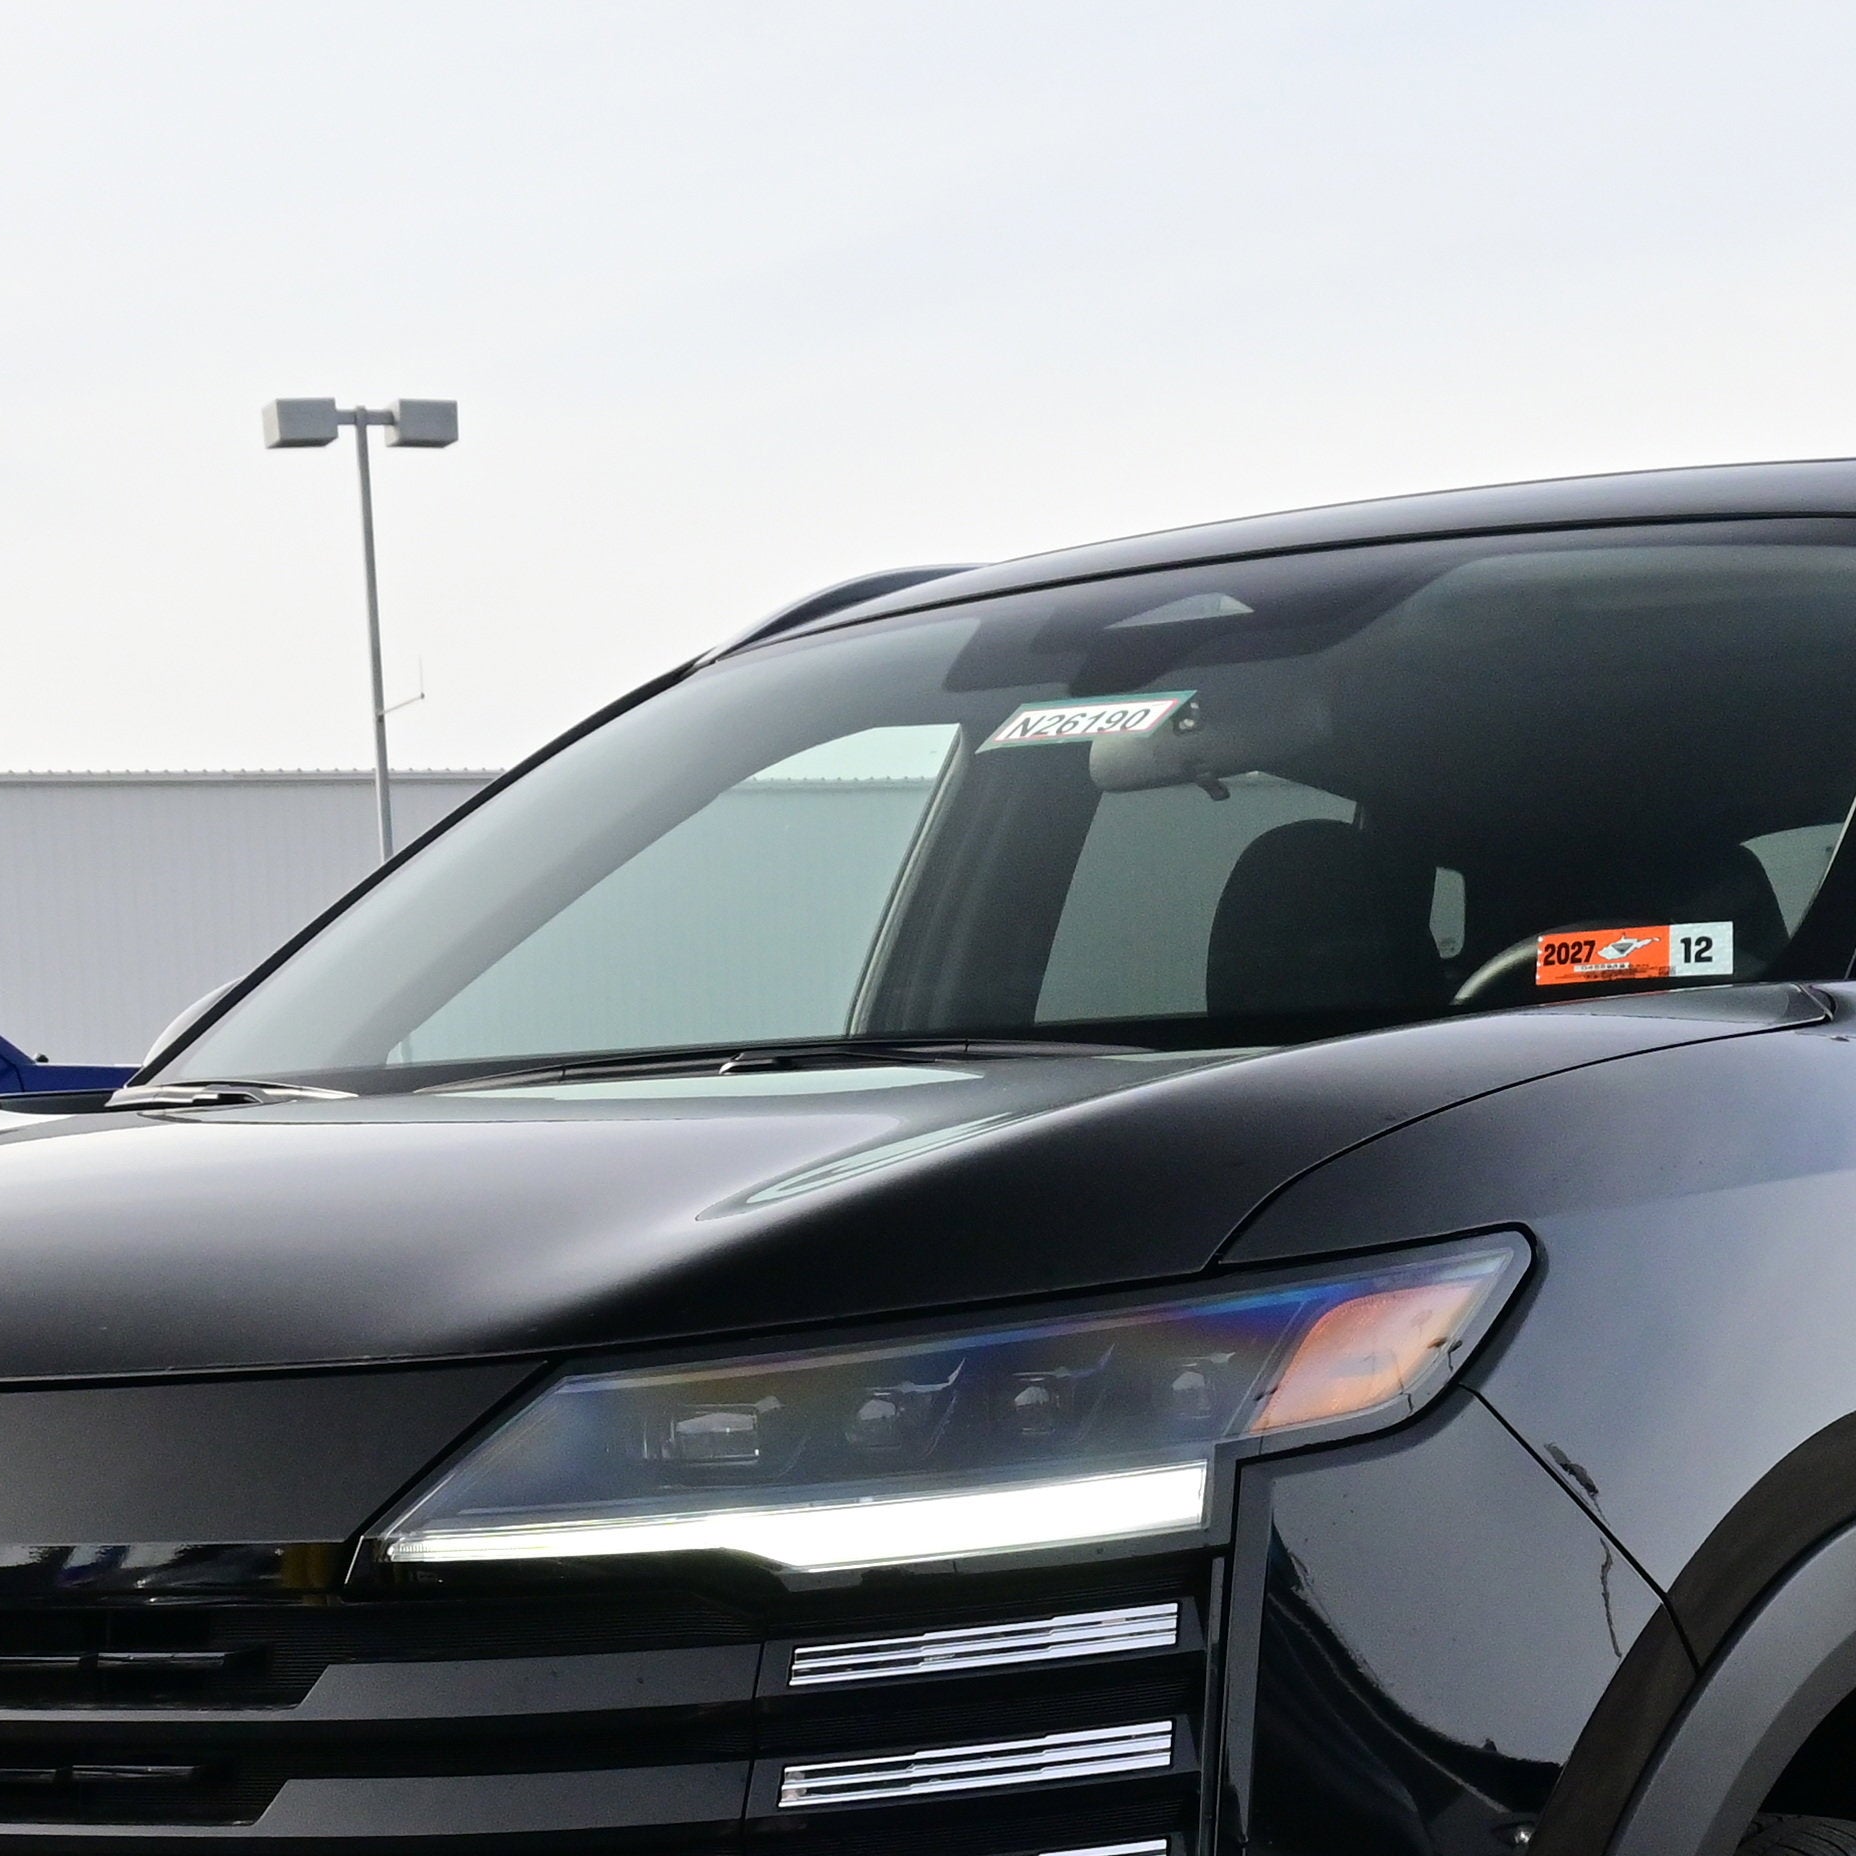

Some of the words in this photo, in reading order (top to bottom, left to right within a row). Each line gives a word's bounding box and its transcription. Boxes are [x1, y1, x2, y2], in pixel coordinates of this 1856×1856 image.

[1004, 707, 1151, 740] N26190
[1543, 940, 1596, 966] 2027
[1679, 936, 1713, 964] 12
